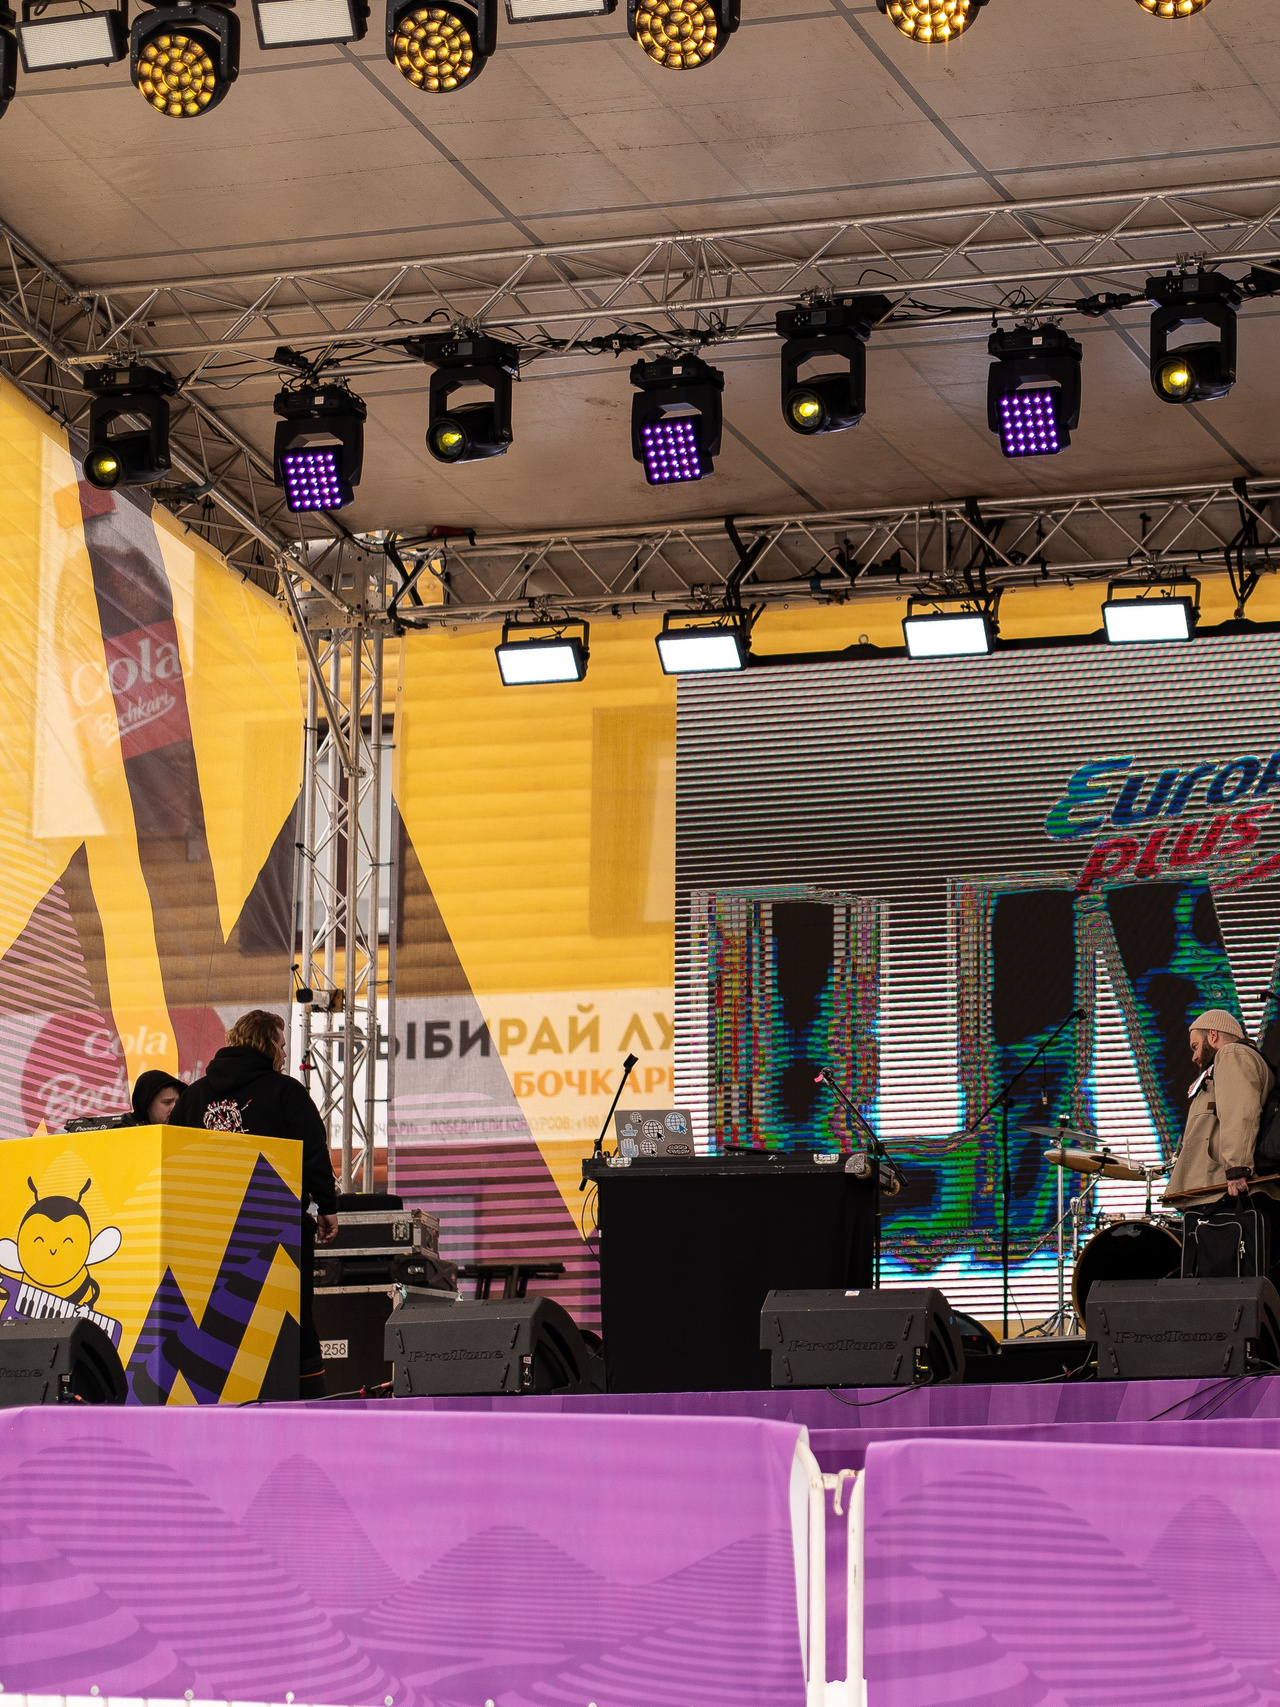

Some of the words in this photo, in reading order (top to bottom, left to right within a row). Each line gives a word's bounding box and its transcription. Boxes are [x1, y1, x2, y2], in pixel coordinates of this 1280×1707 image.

[338, 1003, 600, 1061] ВЫБИРАЙ
[1115, 1330, 1228, 1344] ProTone
[787, 1339, 898, 1352] ProTone
[408, 1349, 506, 1363] ProTone
